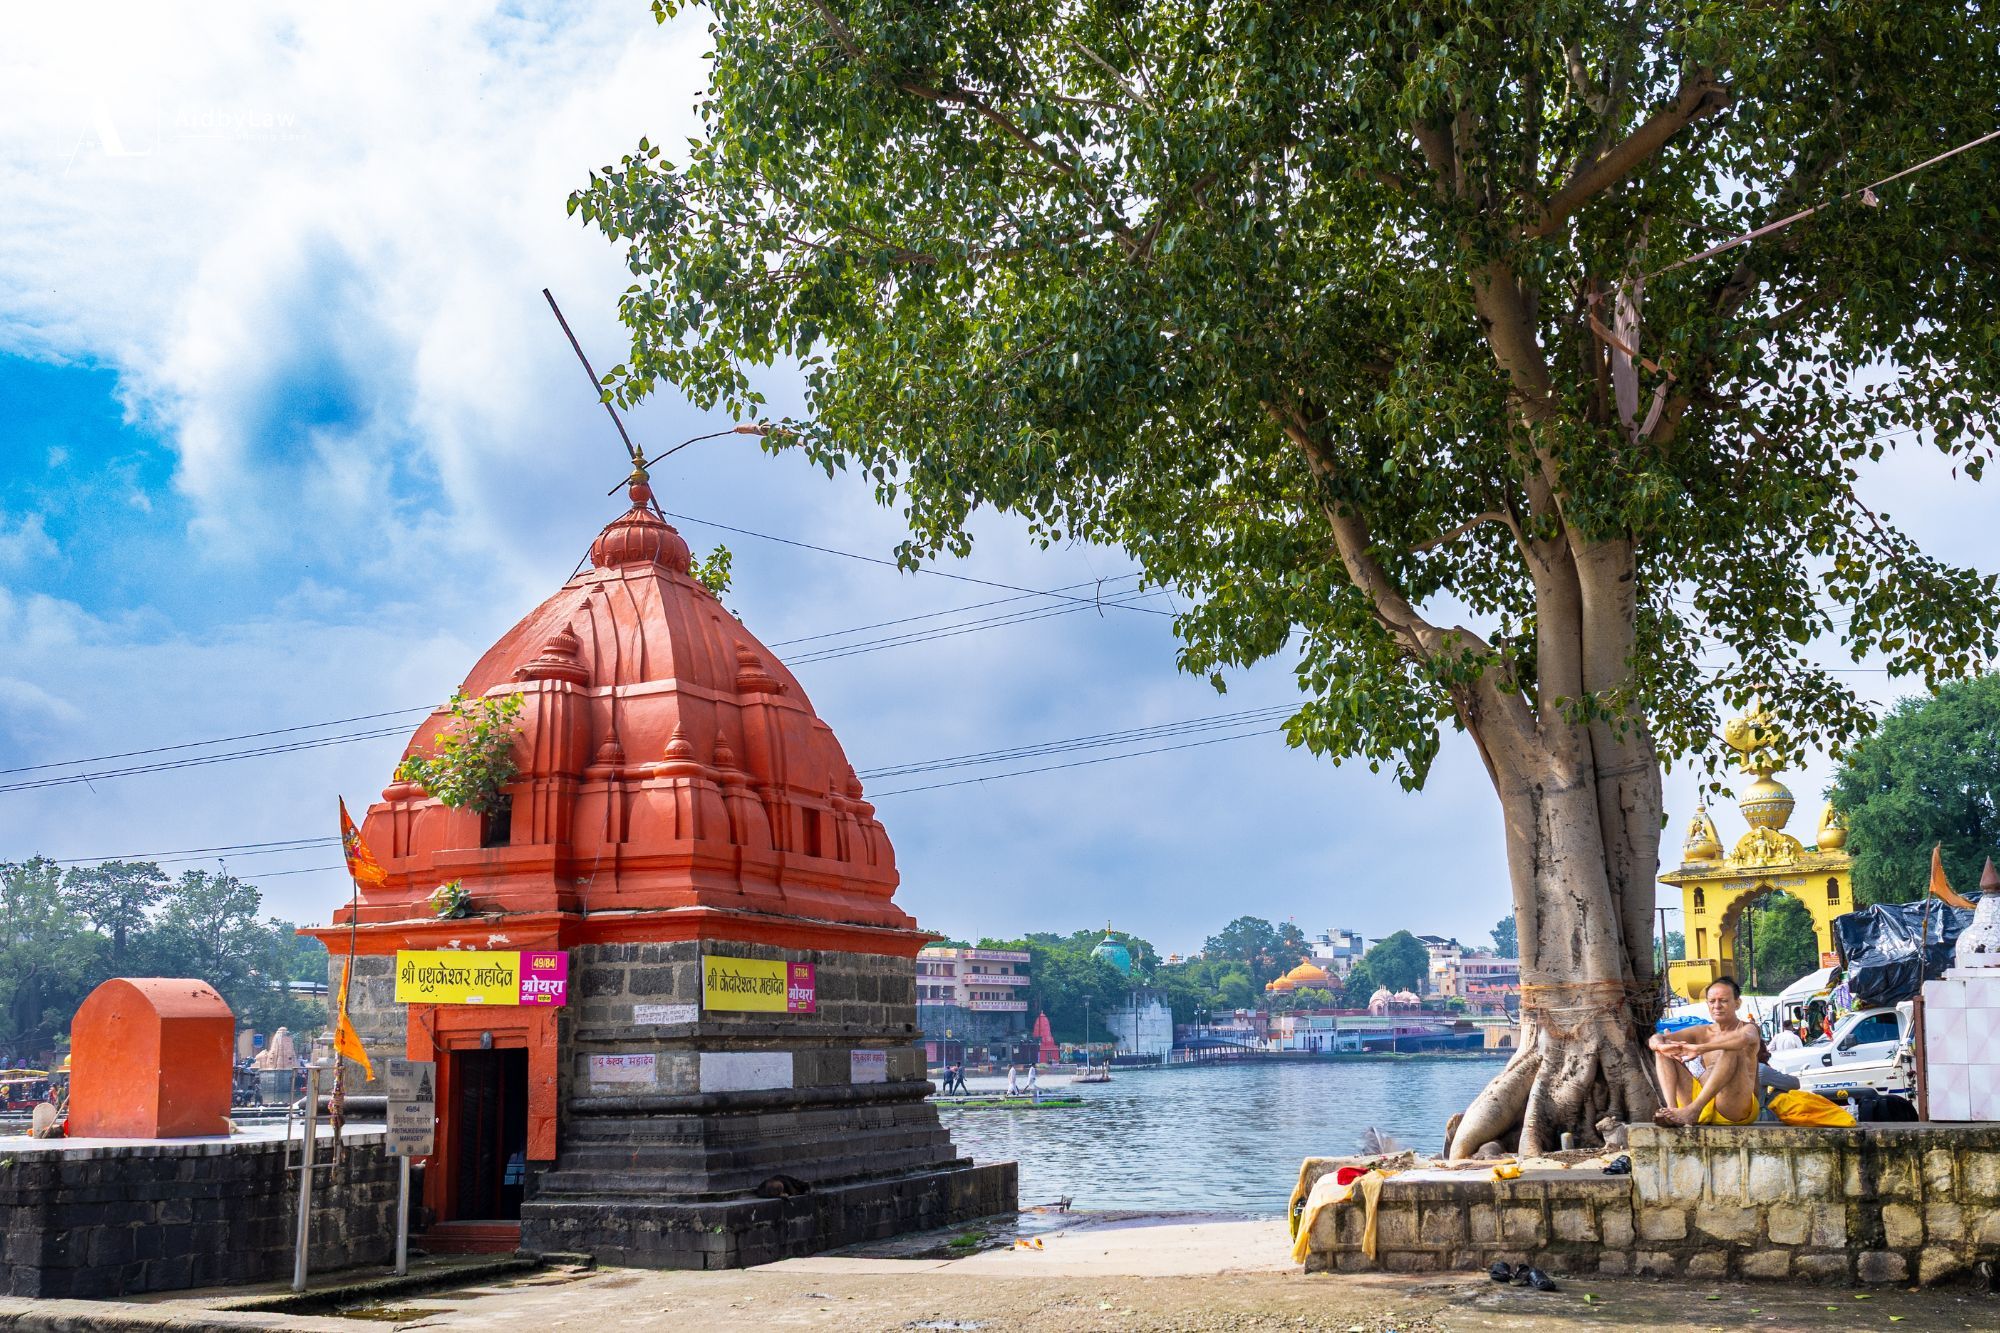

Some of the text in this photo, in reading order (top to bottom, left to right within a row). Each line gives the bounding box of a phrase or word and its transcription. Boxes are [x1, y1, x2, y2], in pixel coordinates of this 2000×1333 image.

[534, 957, 555, 968] 49/84
[402, 960, 513, 992] श्री पृथुकेश्वर महादेव
[521, 974, 564, 995] मोयरा
[707, 967, 784, 995] श्री केदारेश्वर महादेव
[788, 983, 814, 1003] मोयरा
[1814, 1081, 1858, 1089] TOOFAN
